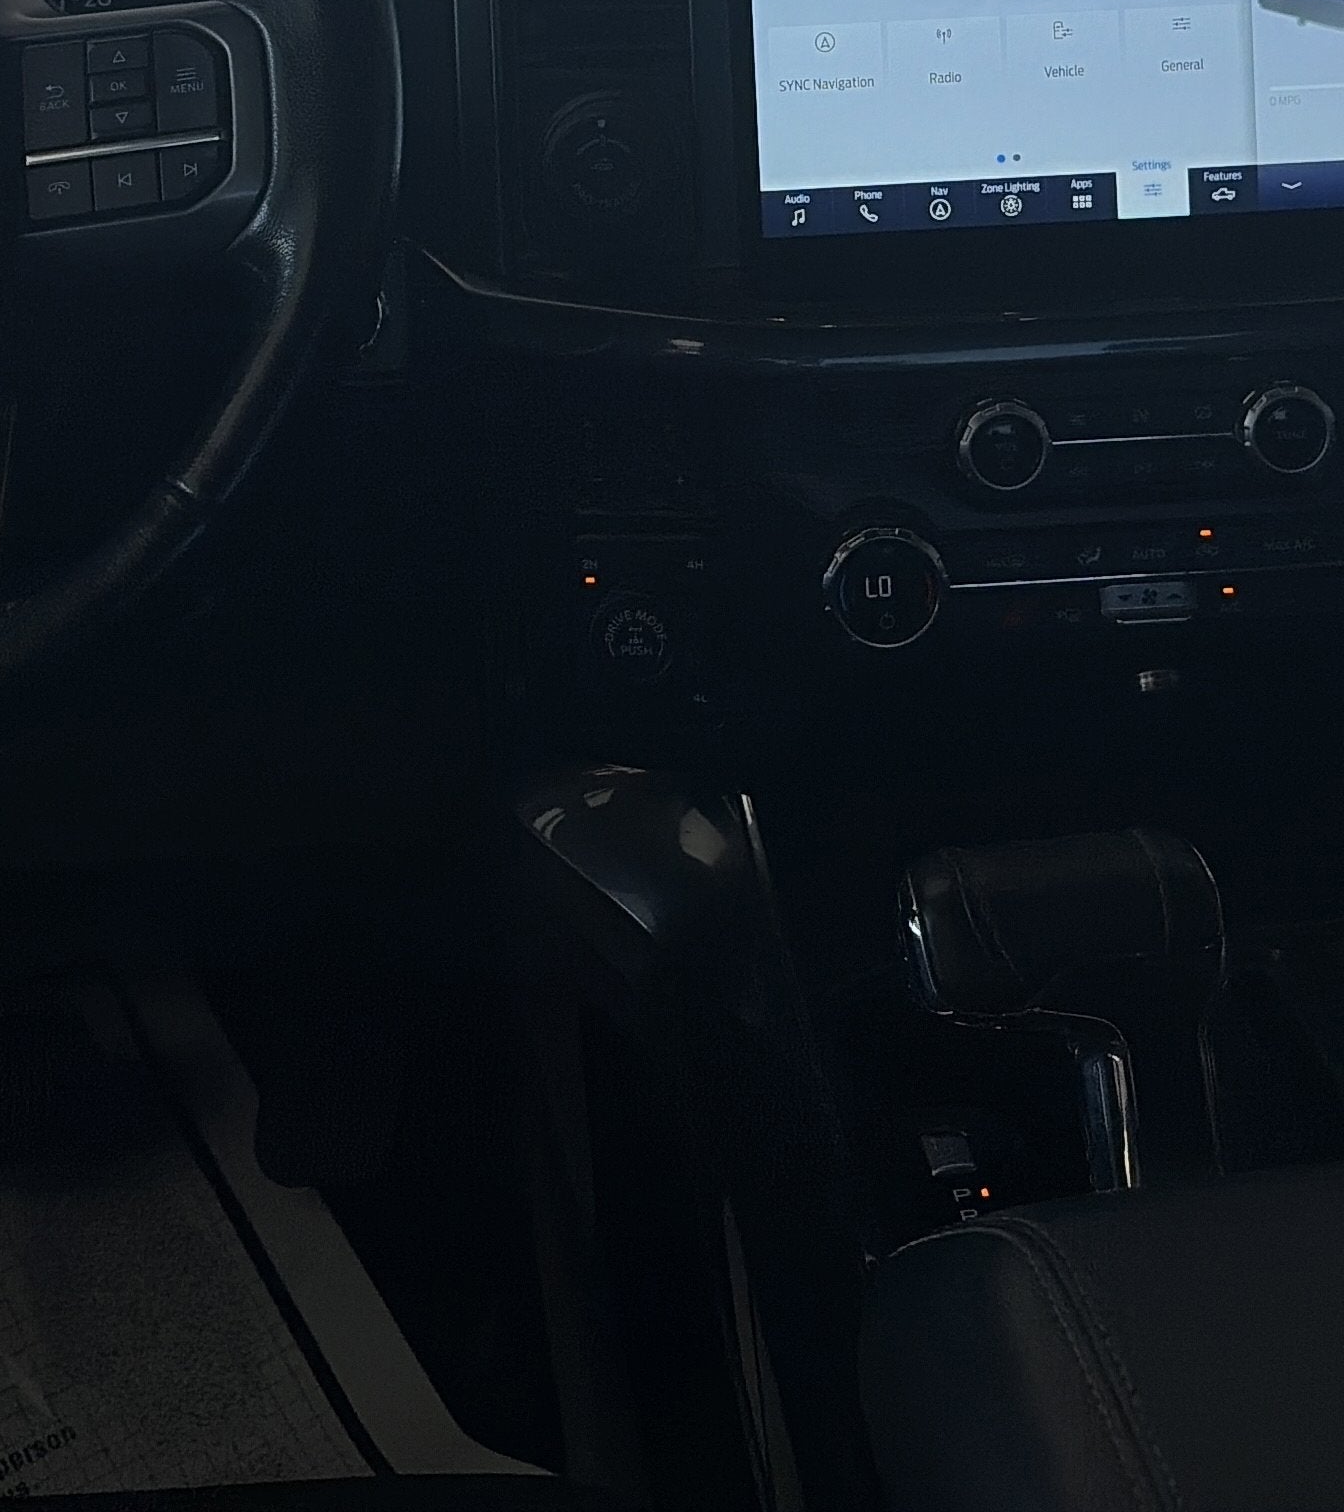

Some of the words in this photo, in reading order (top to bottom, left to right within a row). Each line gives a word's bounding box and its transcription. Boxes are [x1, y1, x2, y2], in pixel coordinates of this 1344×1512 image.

[1161, 58, 1204, 72] General
[1044, 64, 1084, 79] Vehicle
[779, 79, 810, 92] SYNC
[813, 74, 874, 92] Navigation
[929, 71, 962, 85] Radio
[110, 81, 127, 92] OK
[170, 82, 204, 94] MENU
[40, 99, 70, 112] BACK
[1132, 160, 1171, 172] Settings
[1203, 170, 1242, 182] Features
[981, 182, 1003, 194] Zone
[1005, 181, 1040, 194] Lighting
[1071, 178, 1092, 190] Apps
[854, 190, 882, 201] Phone
[931, 187, 948, 197] Nav
[784, 194, 810, 205] Audio
[1131, 548, 1166, 560] AUTO
[865, 575, 892, 598] LO
[605, 609, 633, 642] DRIVE
[635, 609, 669, 640] MODE
[620, 645, 653, 656] PUSH
